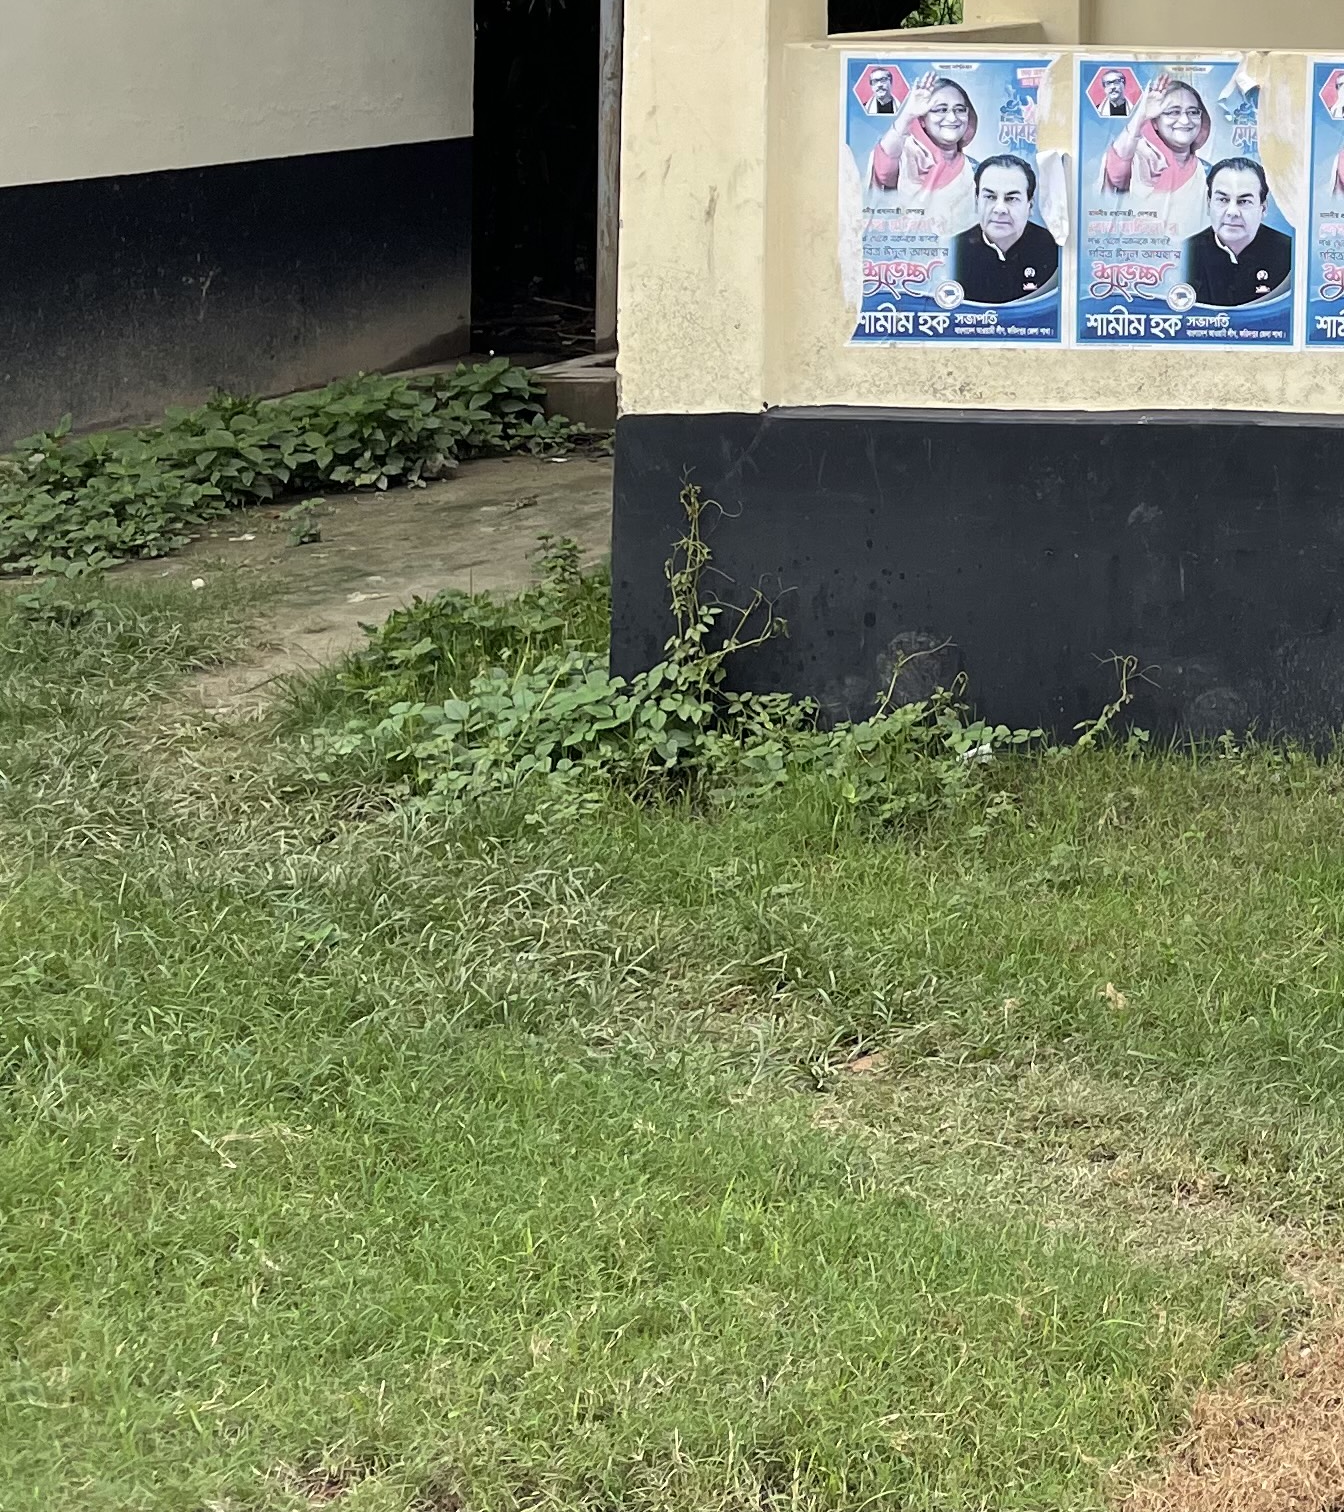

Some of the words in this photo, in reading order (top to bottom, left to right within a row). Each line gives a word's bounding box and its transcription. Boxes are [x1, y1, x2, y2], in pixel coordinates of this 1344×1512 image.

[918, 312, 950, 336] হক
[954, 310, 999, 325] সভাপতি
[1085, 305, 1146, 336] শামীম
[1150, 315, 1183, 338] হক
[1186, 313, 1230, 328] সভাপতি
